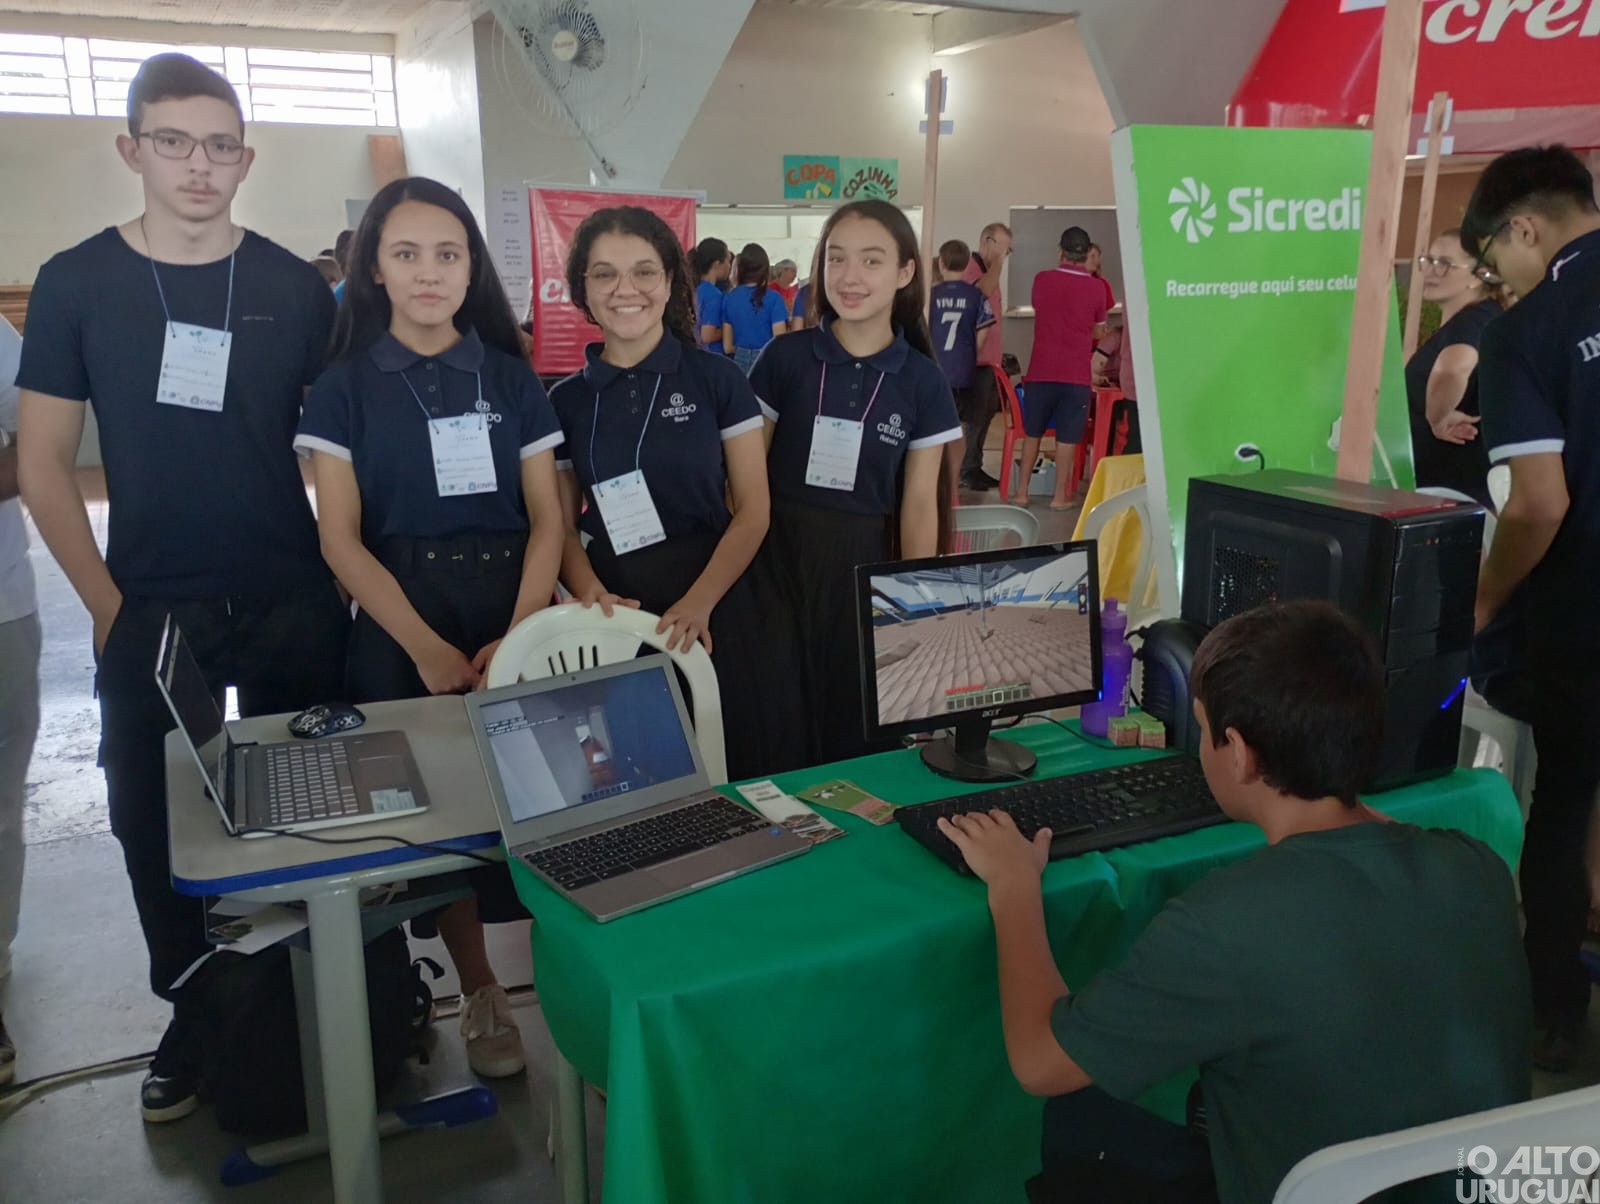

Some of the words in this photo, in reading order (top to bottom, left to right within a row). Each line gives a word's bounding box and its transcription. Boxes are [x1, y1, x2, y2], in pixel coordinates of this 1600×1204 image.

[1425, 0, 1600, 44] cre
[787, 163, 836, 186] COPA
[843, 166, 898, 200] COZINHA
[1227, 187, 1361, 233] Sicredi
[1166, 279, 1258, 299] Recarregue
[1261, 275, 1294, 296] aqui
[1298, 278, 1324, 292] seu
[941, 311, 962, 351] 7
[661, 403, 697, 417] CEEDO
[877, 423, 906, 439] CEEDO
